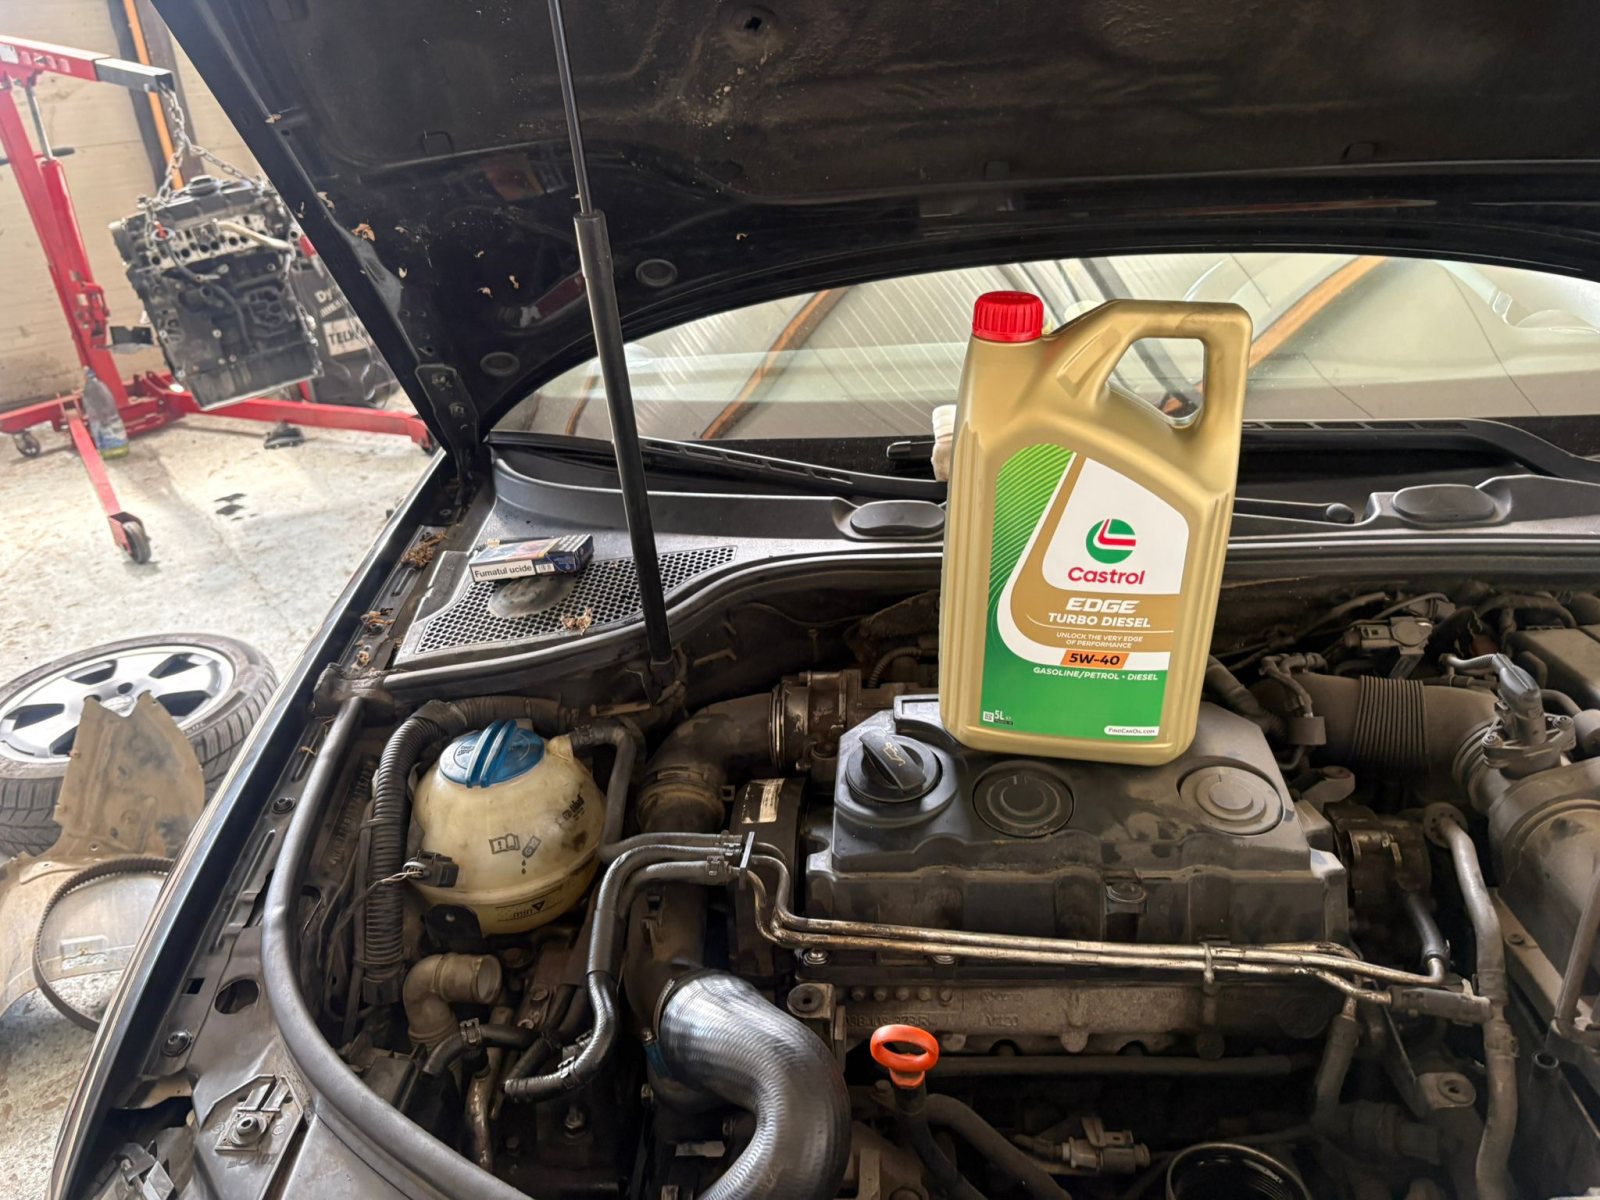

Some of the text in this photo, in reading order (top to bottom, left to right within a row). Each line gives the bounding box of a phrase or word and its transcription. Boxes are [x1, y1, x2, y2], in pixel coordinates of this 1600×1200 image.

[475, 566, 508, 578] Fumatul
[509, 564, 532, 574] ucide
[1067, 566, 1146, 585] Castrol
[1065, 597, 1140, 614] EDGE
[1048, 612, 1151, 628] TURBO DIESEL
[1056, 631, 1087, 640] UNLOCK
[1103, 634, 1123, 642] VERY
[1077, 640, 1132, 649] PERFORMANCE
[1068, 652, 1121, 666] 5W-40
[1033, 667, 1158, 681] GASOLINE/PETROL DIESEL
[994, 709, 1005, 720] 5L
